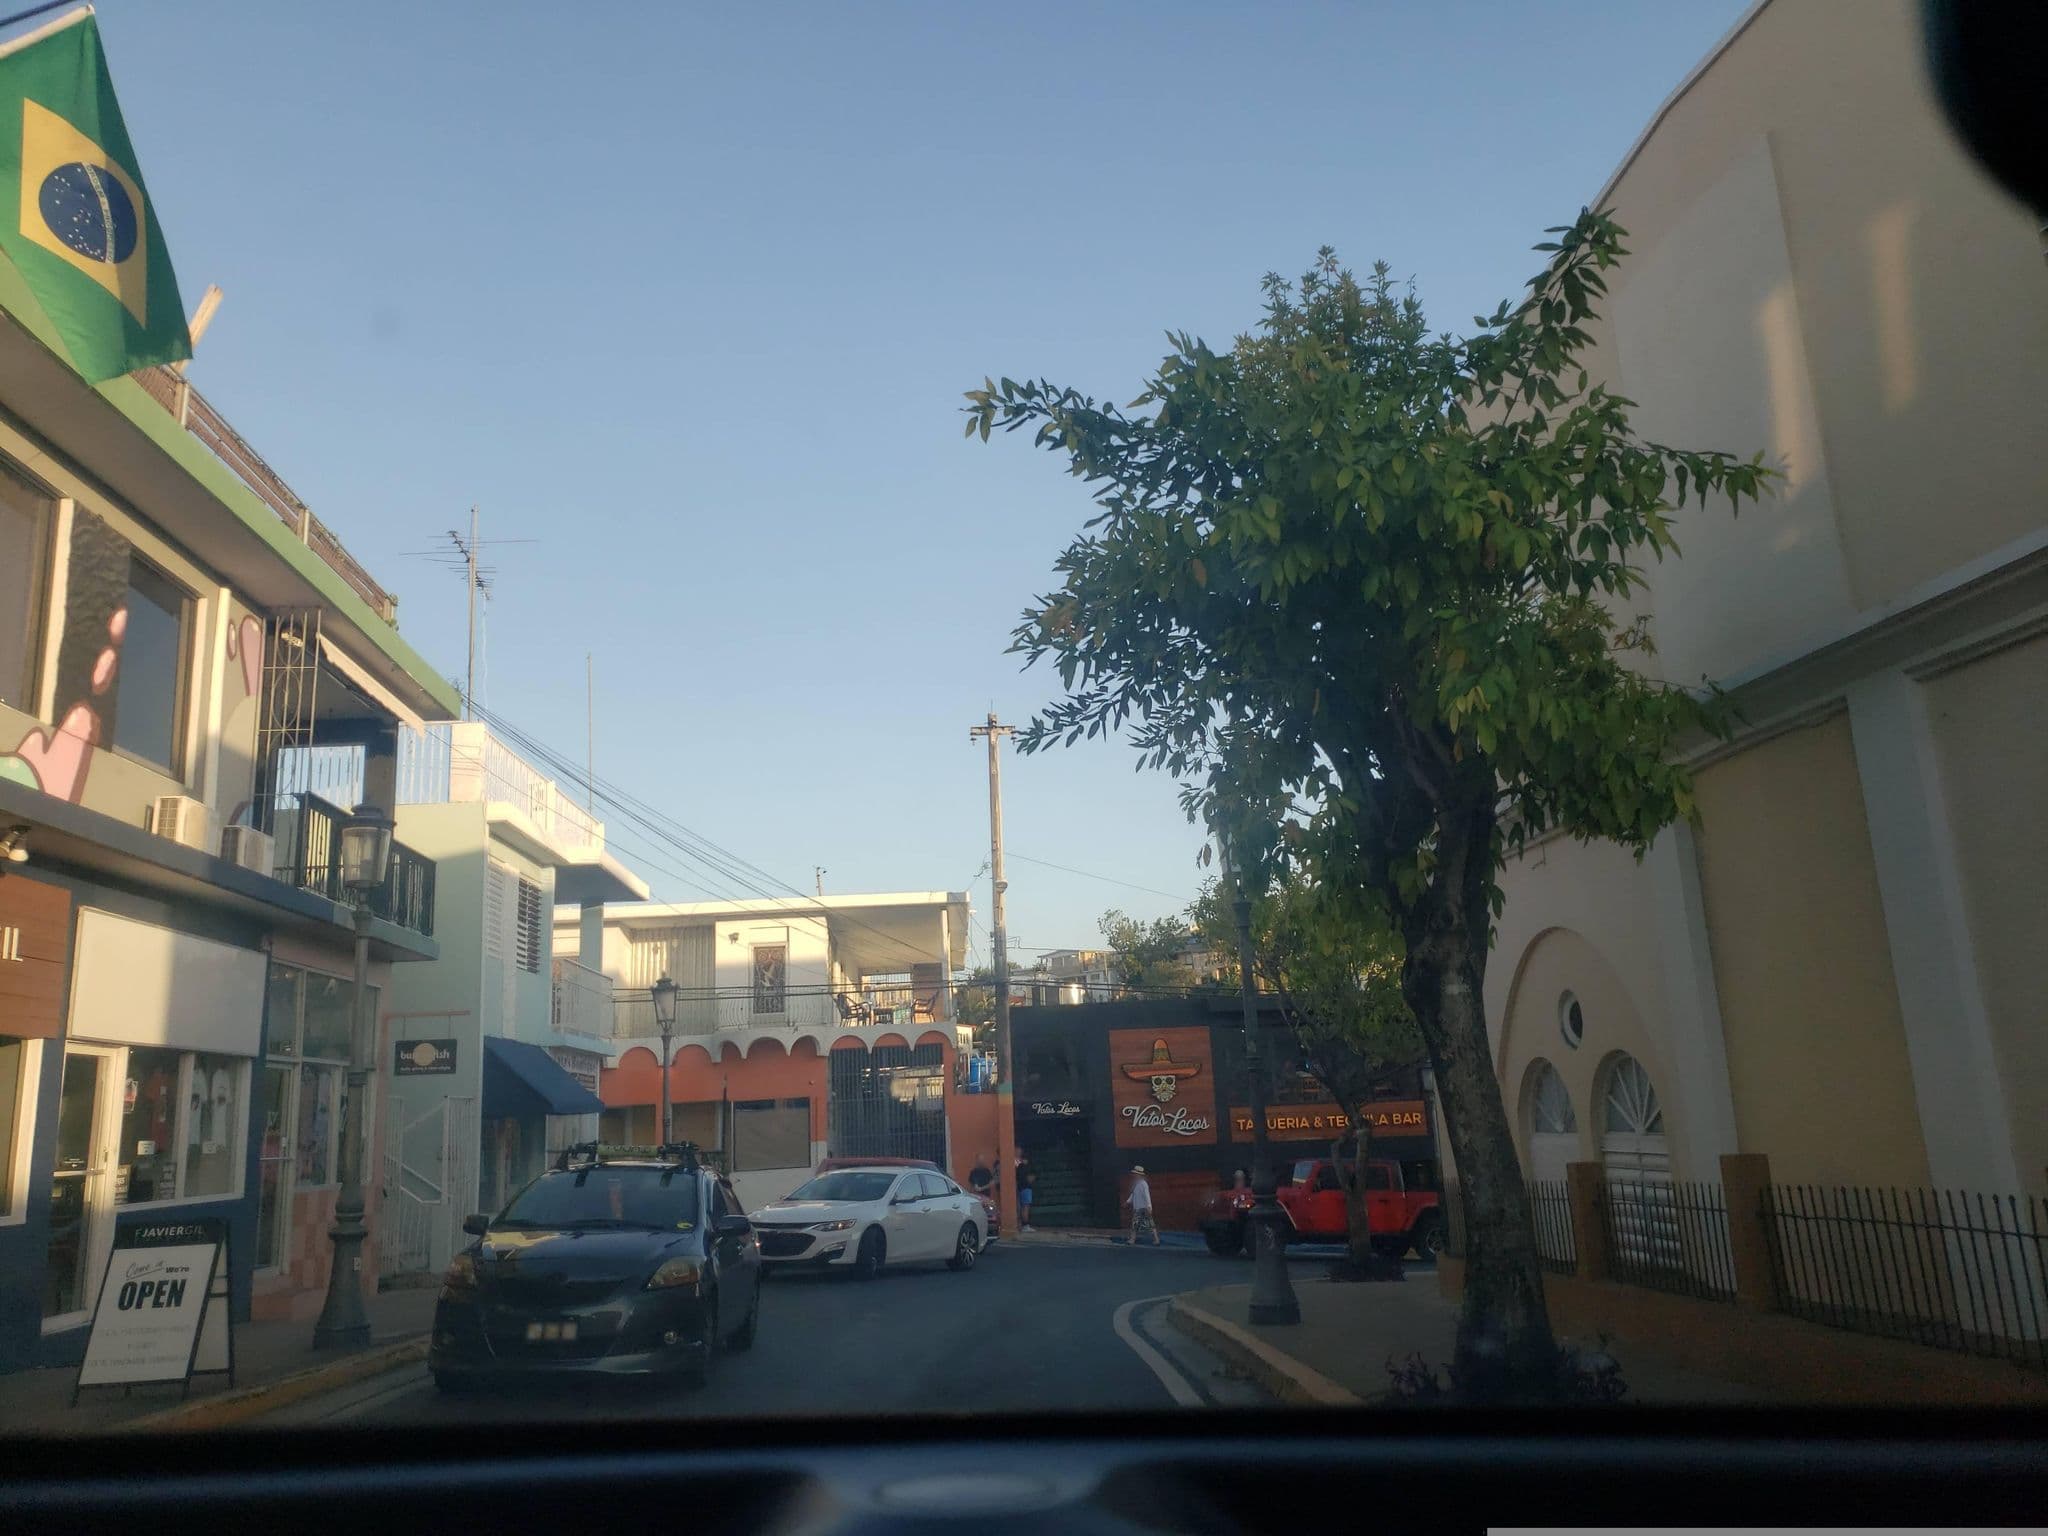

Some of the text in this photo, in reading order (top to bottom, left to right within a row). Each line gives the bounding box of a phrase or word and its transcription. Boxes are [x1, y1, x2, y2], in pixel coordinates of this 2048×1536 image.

[0, 926, 23, 962] IL
[1122, 1104, 1210, 1136] Vatos Locos
[1236, 1116, 1309, 1131] TAUERIA
[1313, 1116, 1323, 1128] &
[1393, 1111, 1422, 1126] BAR
[118, 1279, 187, 1311] OPEN
